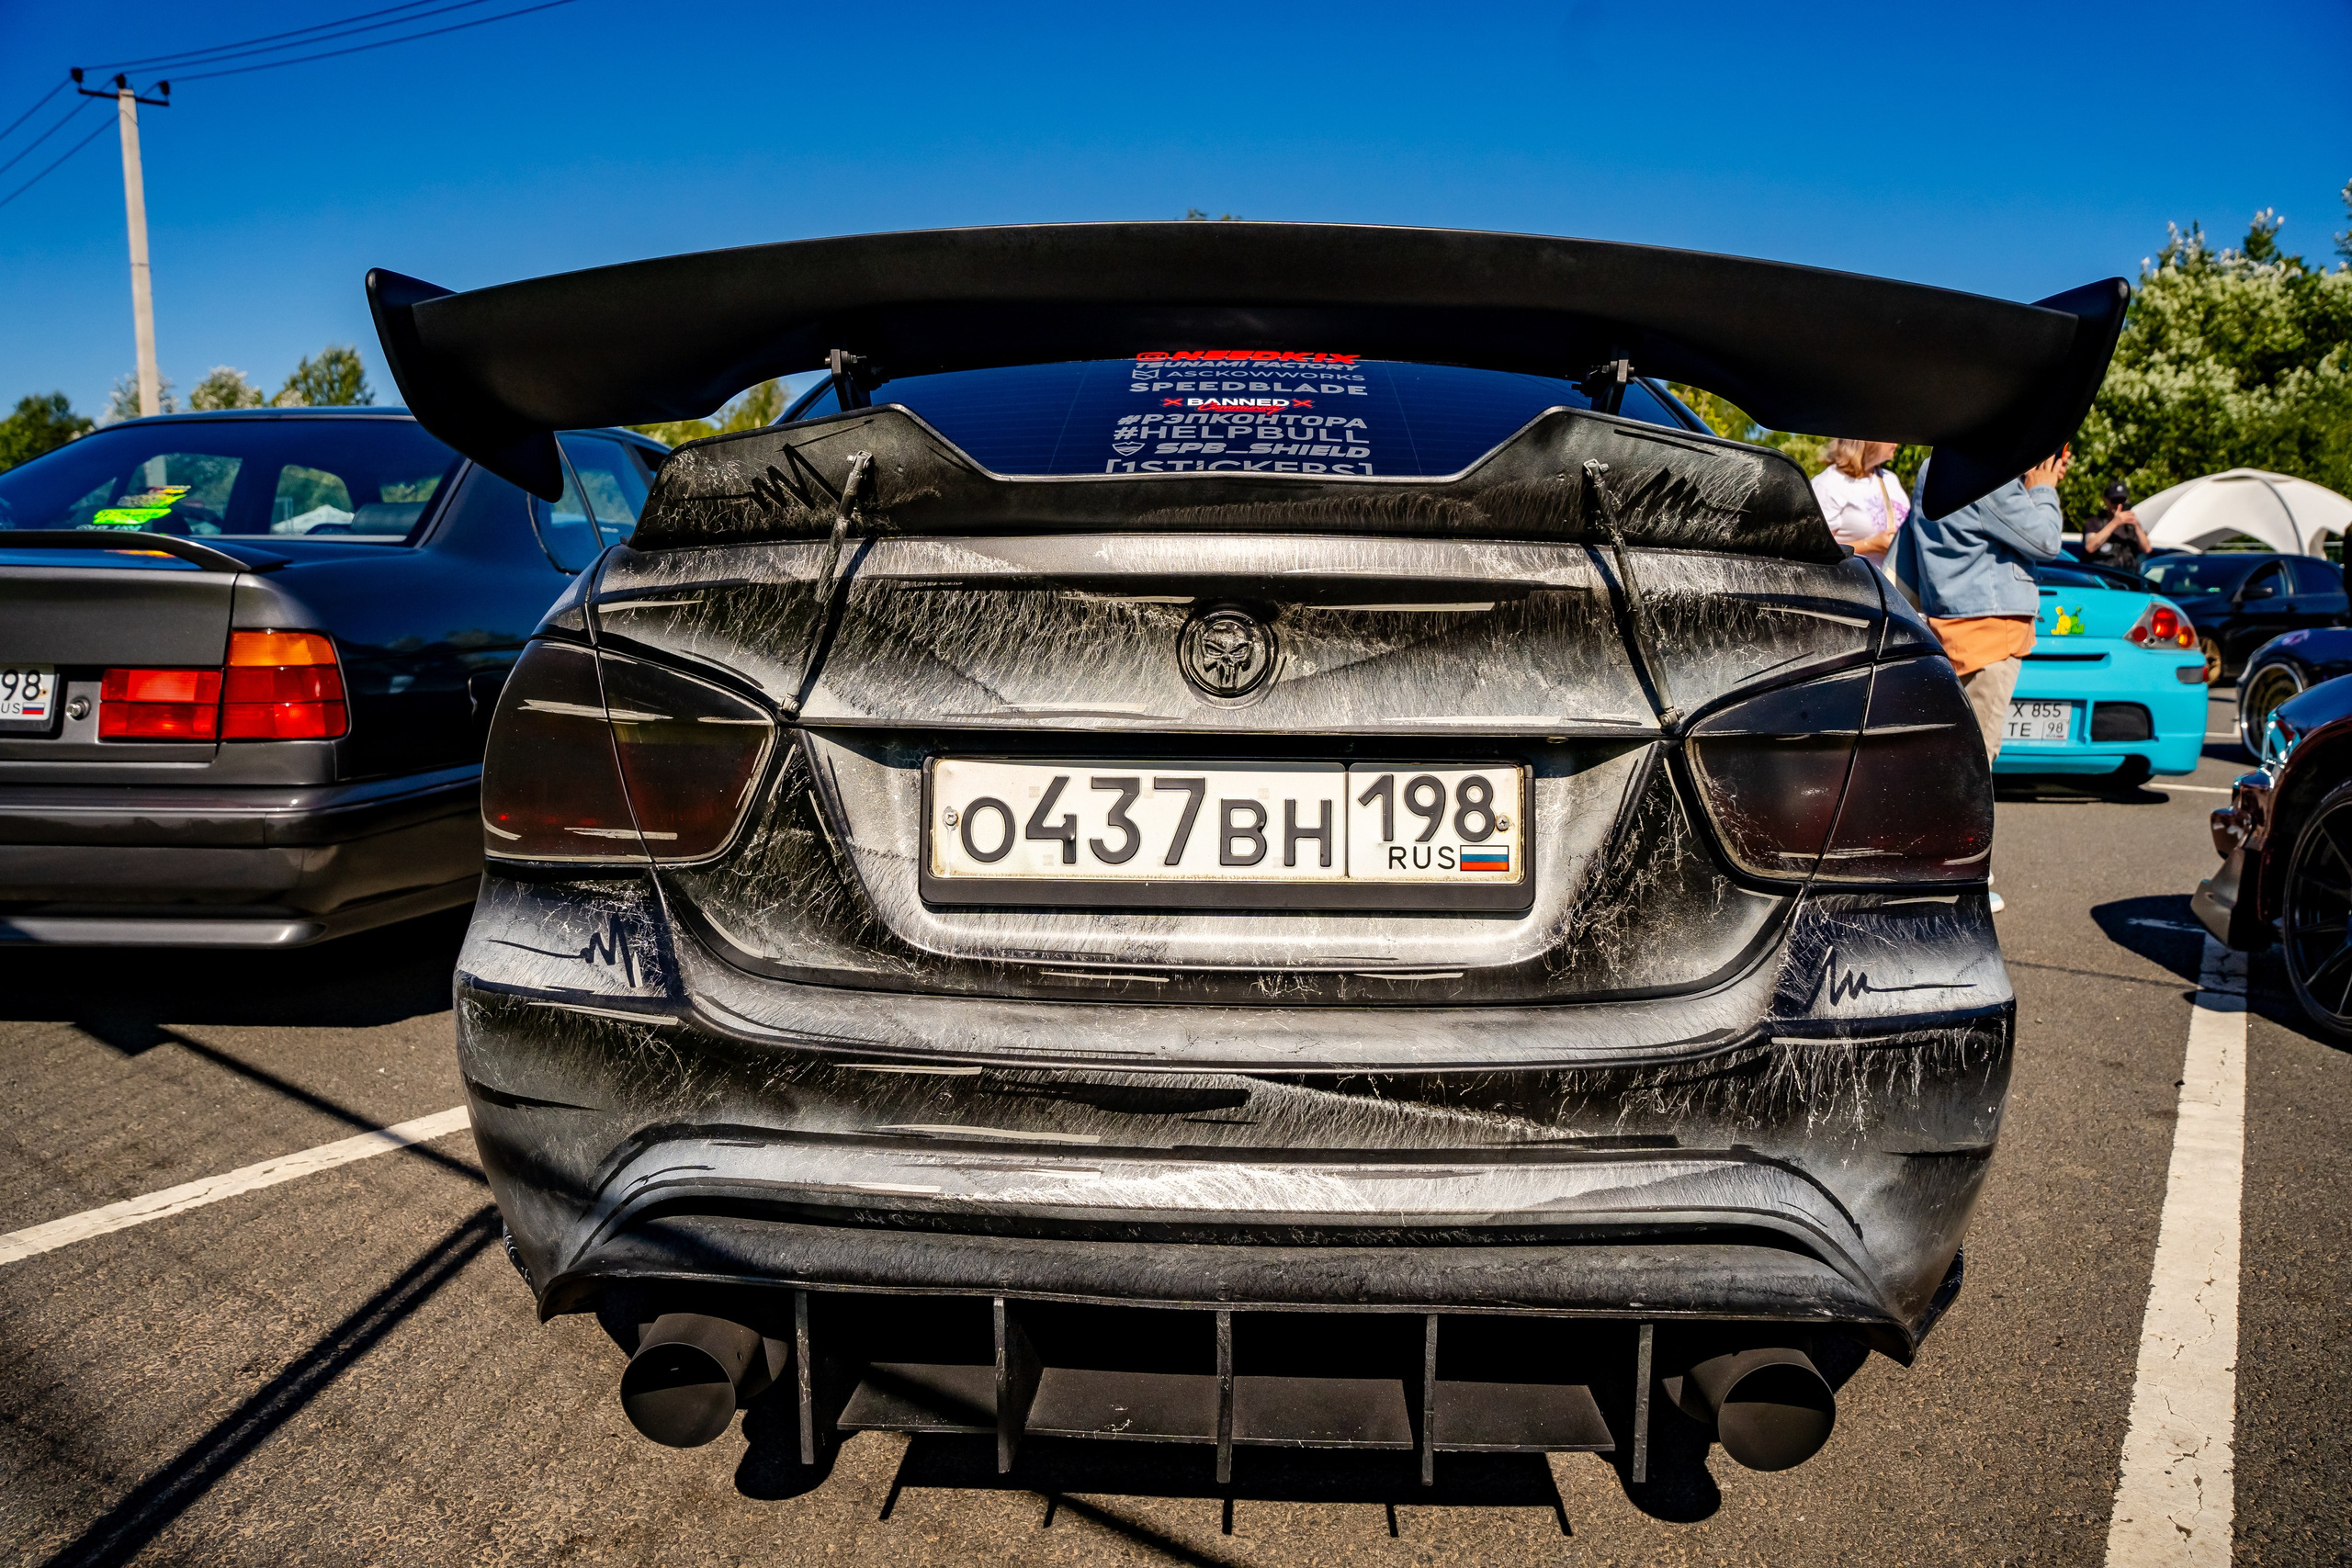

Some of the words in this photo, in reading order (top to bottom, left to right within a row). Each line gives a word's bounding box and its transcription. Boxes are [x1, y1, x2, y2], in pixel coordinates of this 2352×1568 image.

[1135, 361, 1248, 369] TSUNAMI
[1251, 361, 1361, 371] FACTORY
[1167, 370, 1365, 381] ASCKOWWORKS
[1129, 381, 1368, 395] SPEEDBLADE
[1187, 398, 1290, 407] BANNED
[1117, 413, 1368, 429] #РЭПКОНТОРА
[1114, 425, 1370, 444] #HELPBULL
[1154, 442, 1371, 458] SPB_SHIELD
[2, 669, 40, 701] 98
[2031, 703, 2062, 718] 855
[2048, 721, 2064, 734] 98
[1357, 773, 1497, 843] 198
[1388, 845, 1456, 870] RUS
